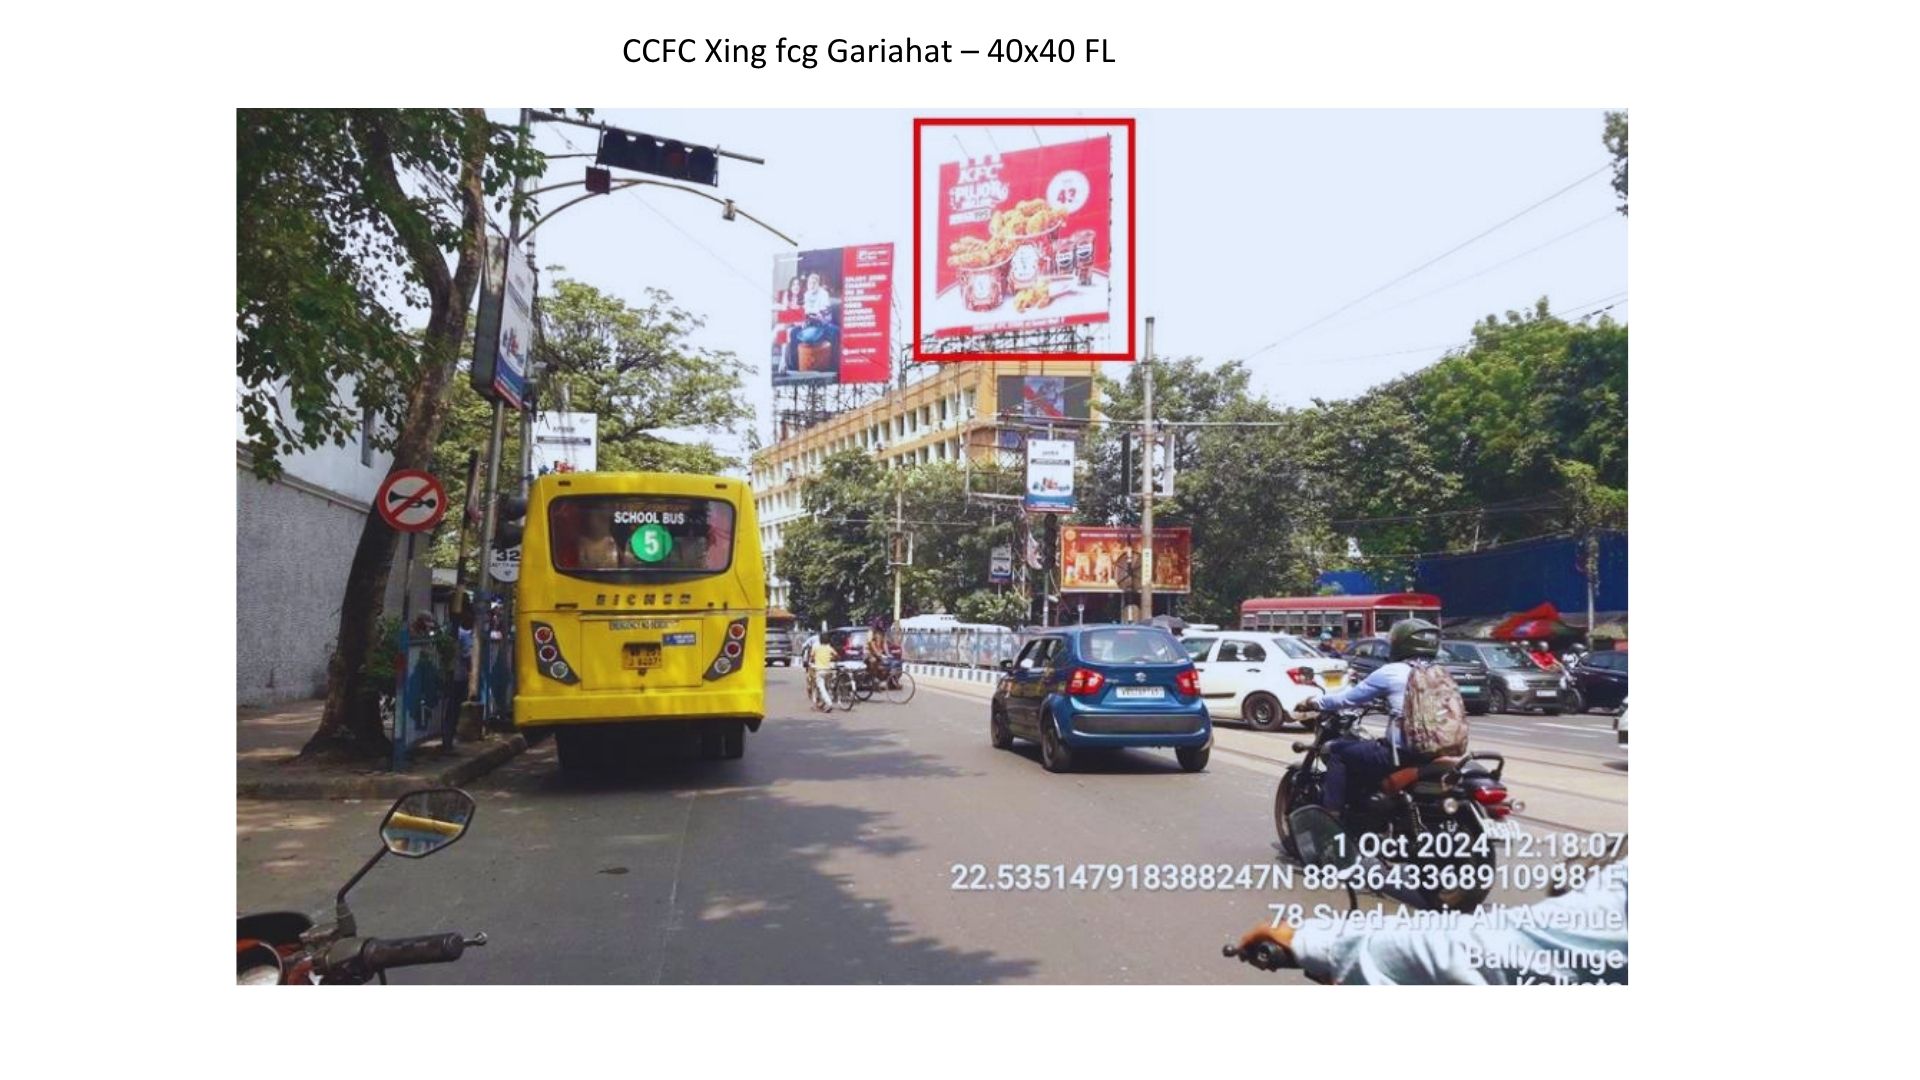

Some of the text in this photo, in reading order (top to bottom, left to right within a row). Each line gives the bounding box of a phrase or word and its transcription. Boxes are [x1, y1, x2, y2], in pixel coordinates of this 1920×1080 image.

[614, 510, 685, 526] SCHOOL BUS
[643, 530, 660, 555] 5
[496, 549, 521, 562] 32
